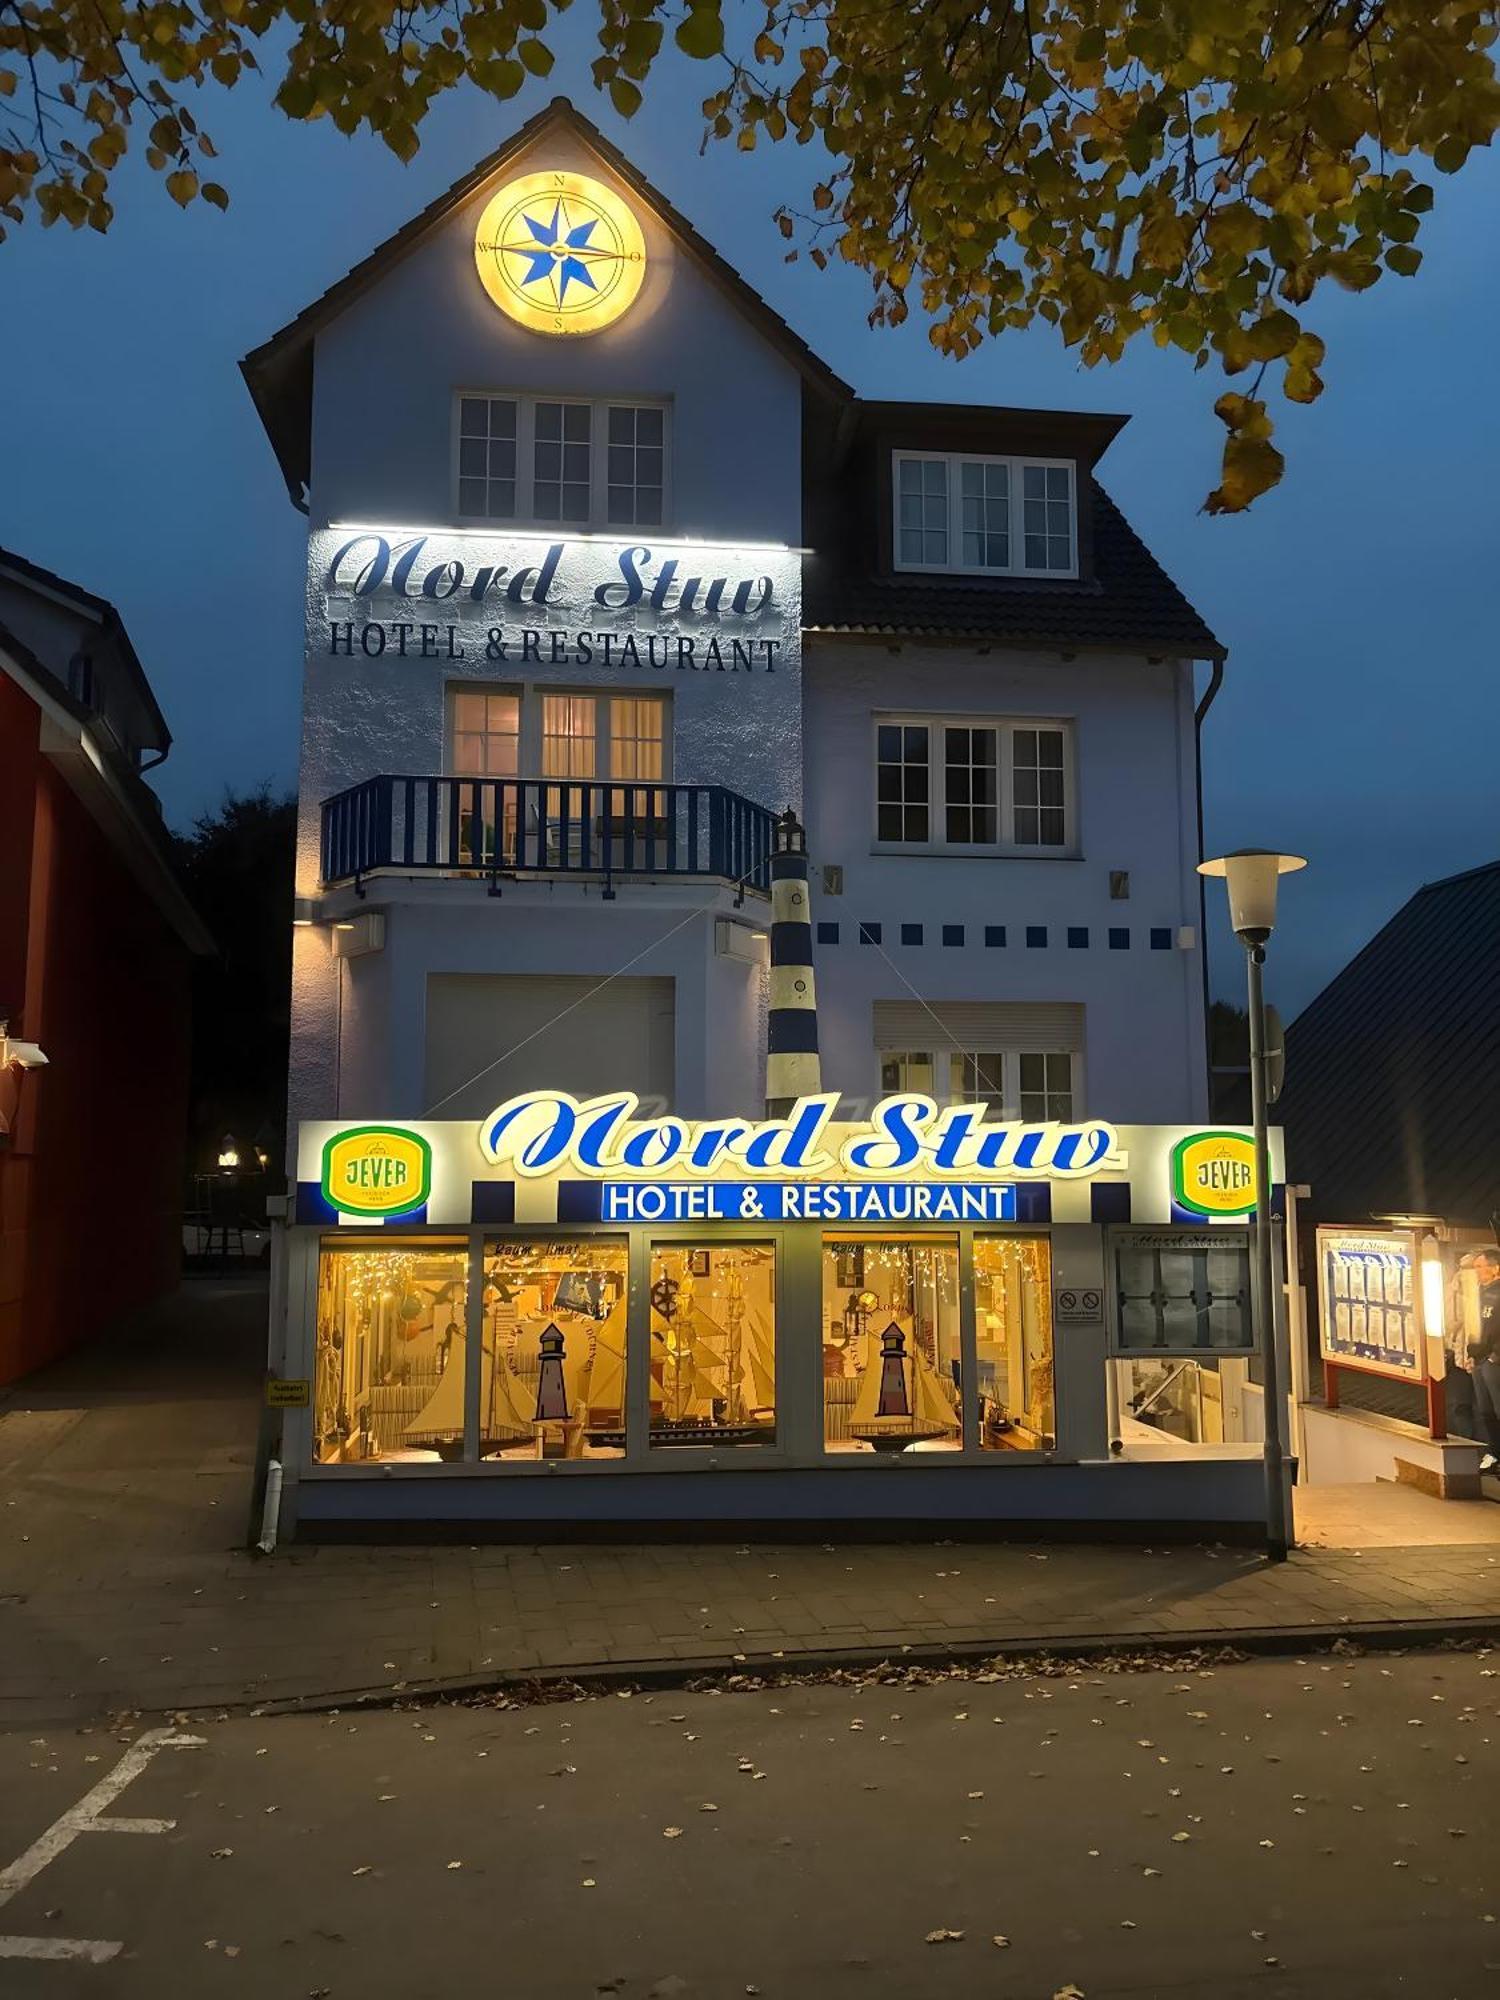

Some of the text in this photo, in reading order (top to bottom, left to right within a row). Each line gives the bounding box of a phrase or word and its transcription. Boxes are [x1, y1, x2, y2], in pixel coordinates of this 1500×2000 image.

[553, 174, 565, 186] N
[478, 242, 491, 252] W
[554, 317, 563, 328] S
[328, 535, 565, 604] Nord
[329, 621, 780, 673] HOTEL & RESTAURANT
[487, 1098, 832, 1169] Nord
[346, 1157, 406, 1188] JEVER
[1198, 1160, 1251, 1190] JEVER
[609, 1185, 1009, 1219] HOTEL & RESTAURANT
